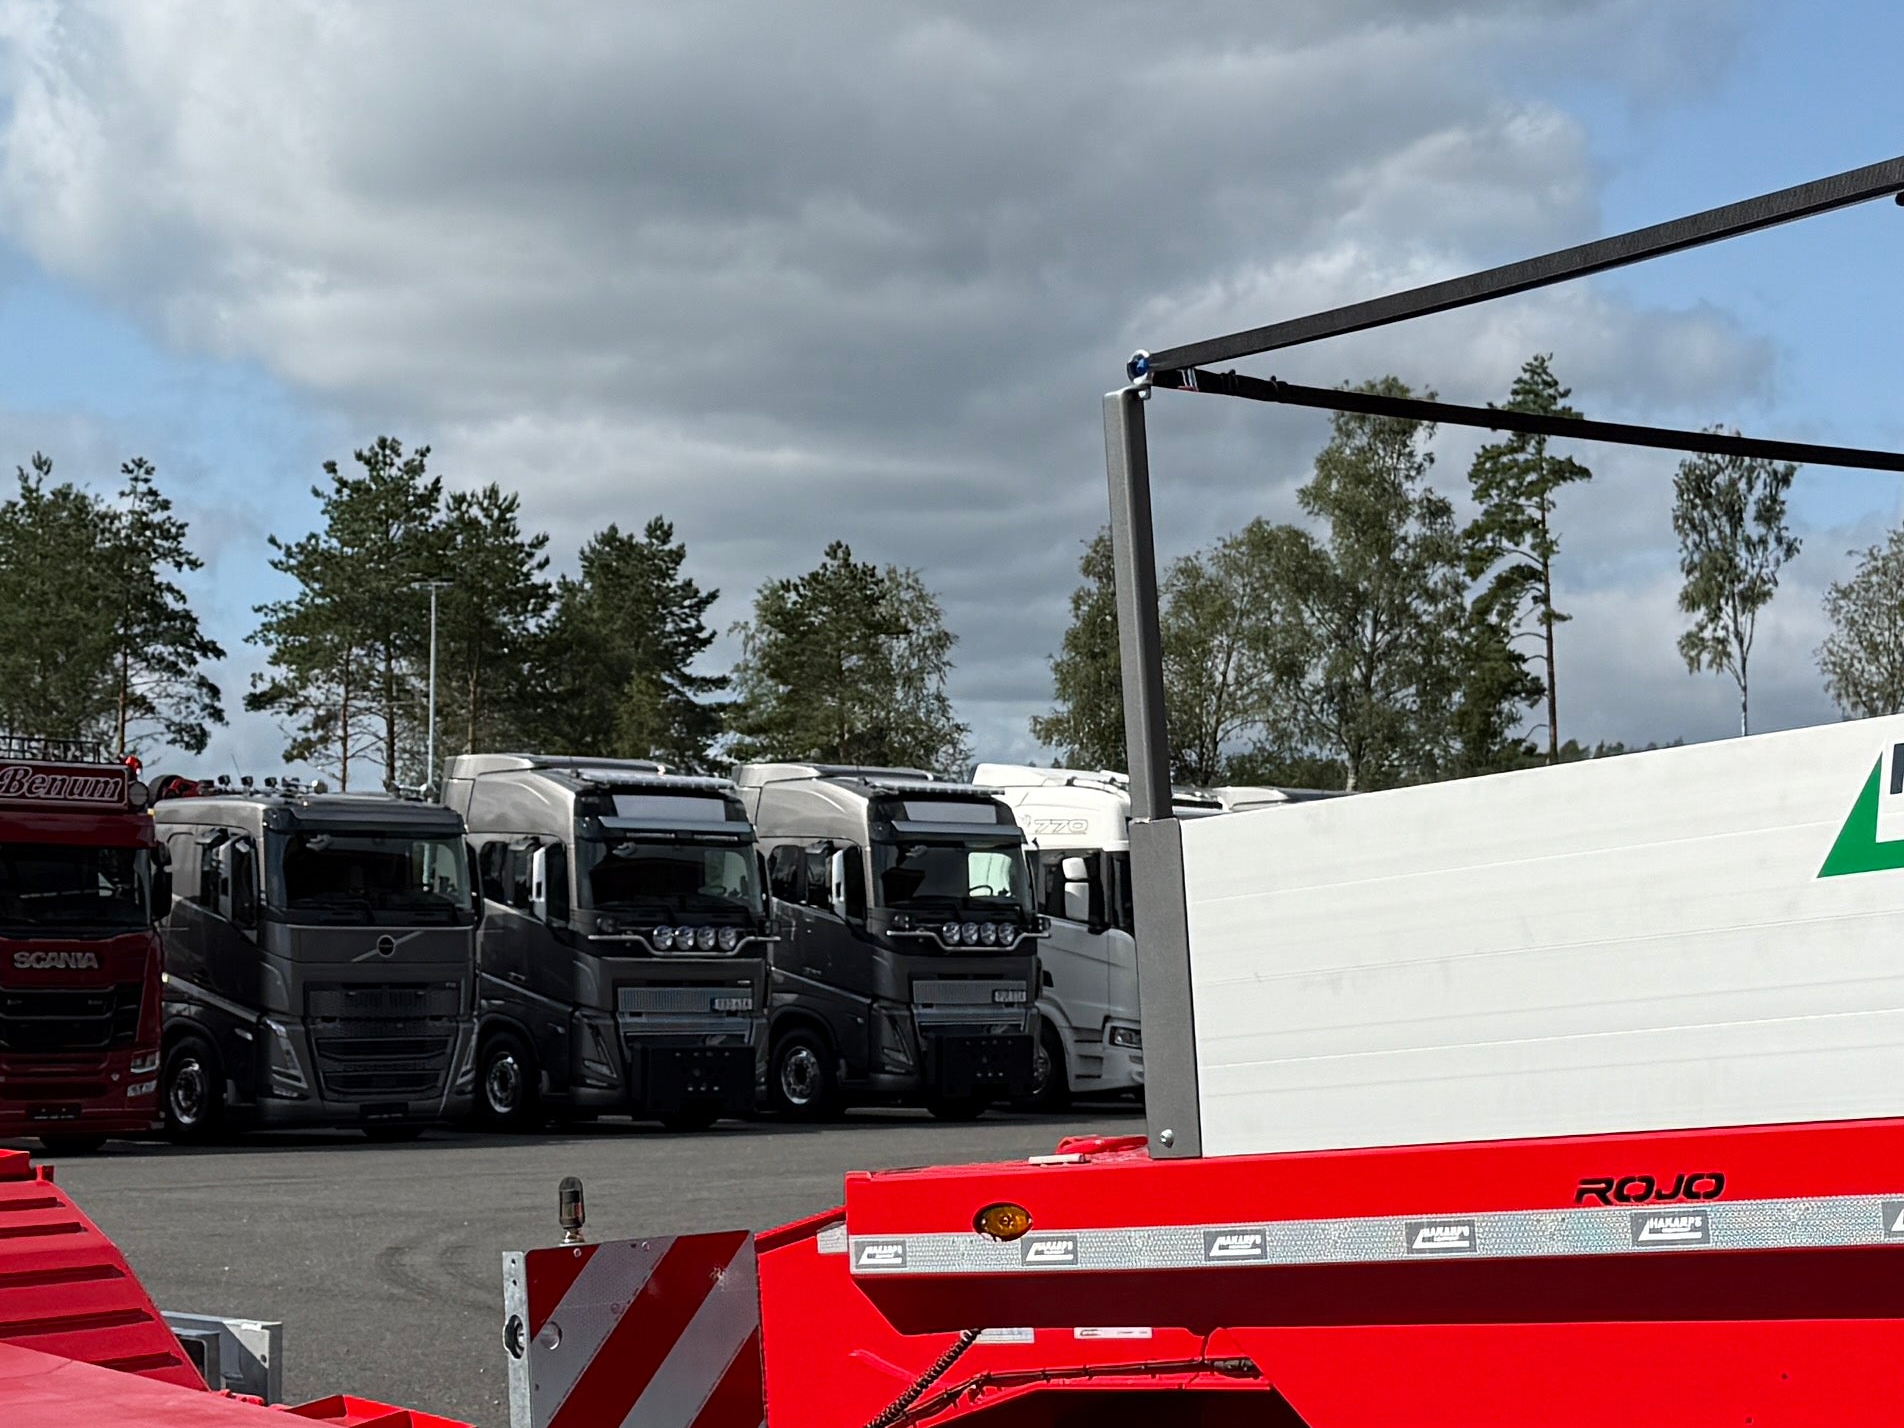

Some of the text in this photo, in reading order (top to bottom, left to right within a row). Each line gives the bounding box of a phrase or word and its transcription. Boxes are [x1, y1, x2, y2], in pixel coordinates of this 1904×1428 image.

[1034, 819, 1088, 834] 770
[14, 951, 98, 969] SCANIA
[1575, 1173, 1725, 1205] ROJO
